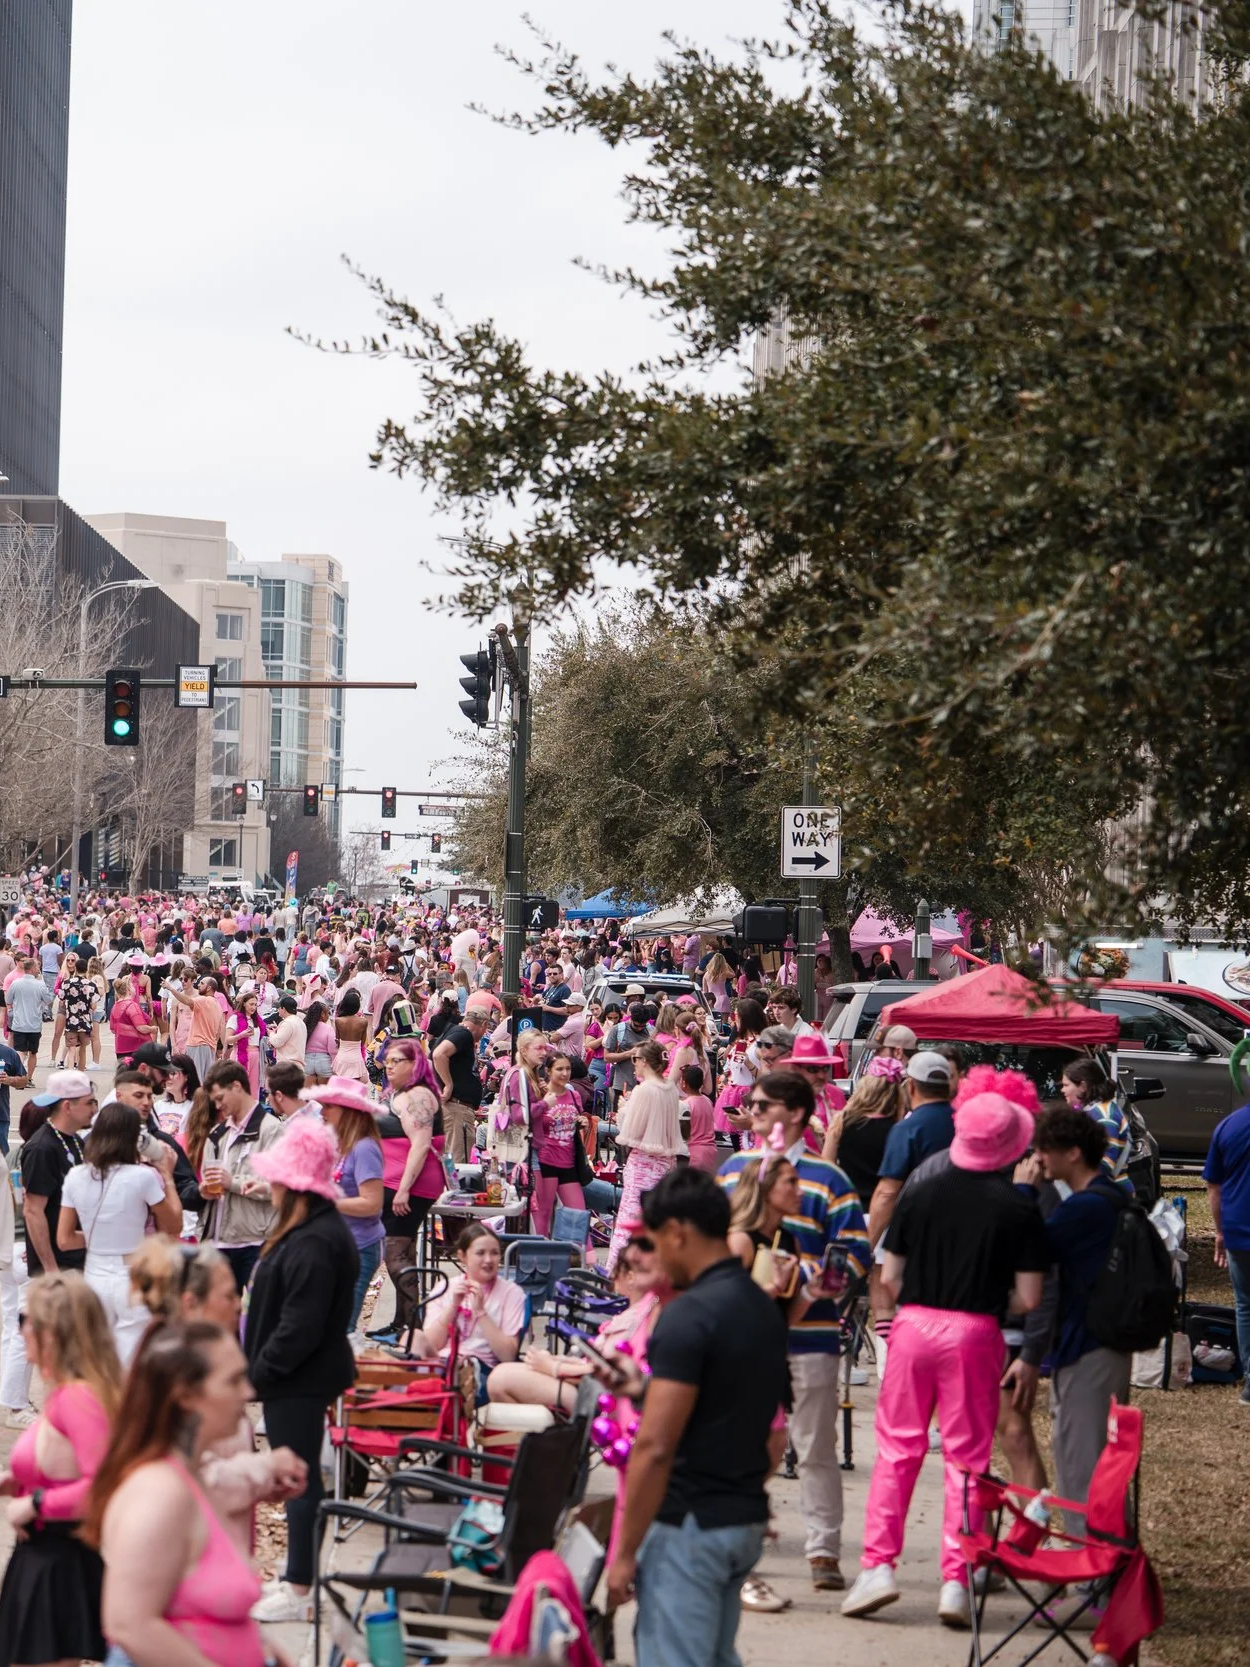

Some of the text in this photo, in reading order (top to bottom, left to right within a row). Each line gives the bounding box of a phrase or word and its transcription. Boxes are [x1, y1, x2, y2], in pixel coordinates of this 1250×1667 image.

[184, 682, 205, 690] YIELD
[793, 812, 831, 828] ONE
[792, 831, 832, 847] WAY
[2, 891, 18, 901] 30
[523, 1021, 529, 1029] P
